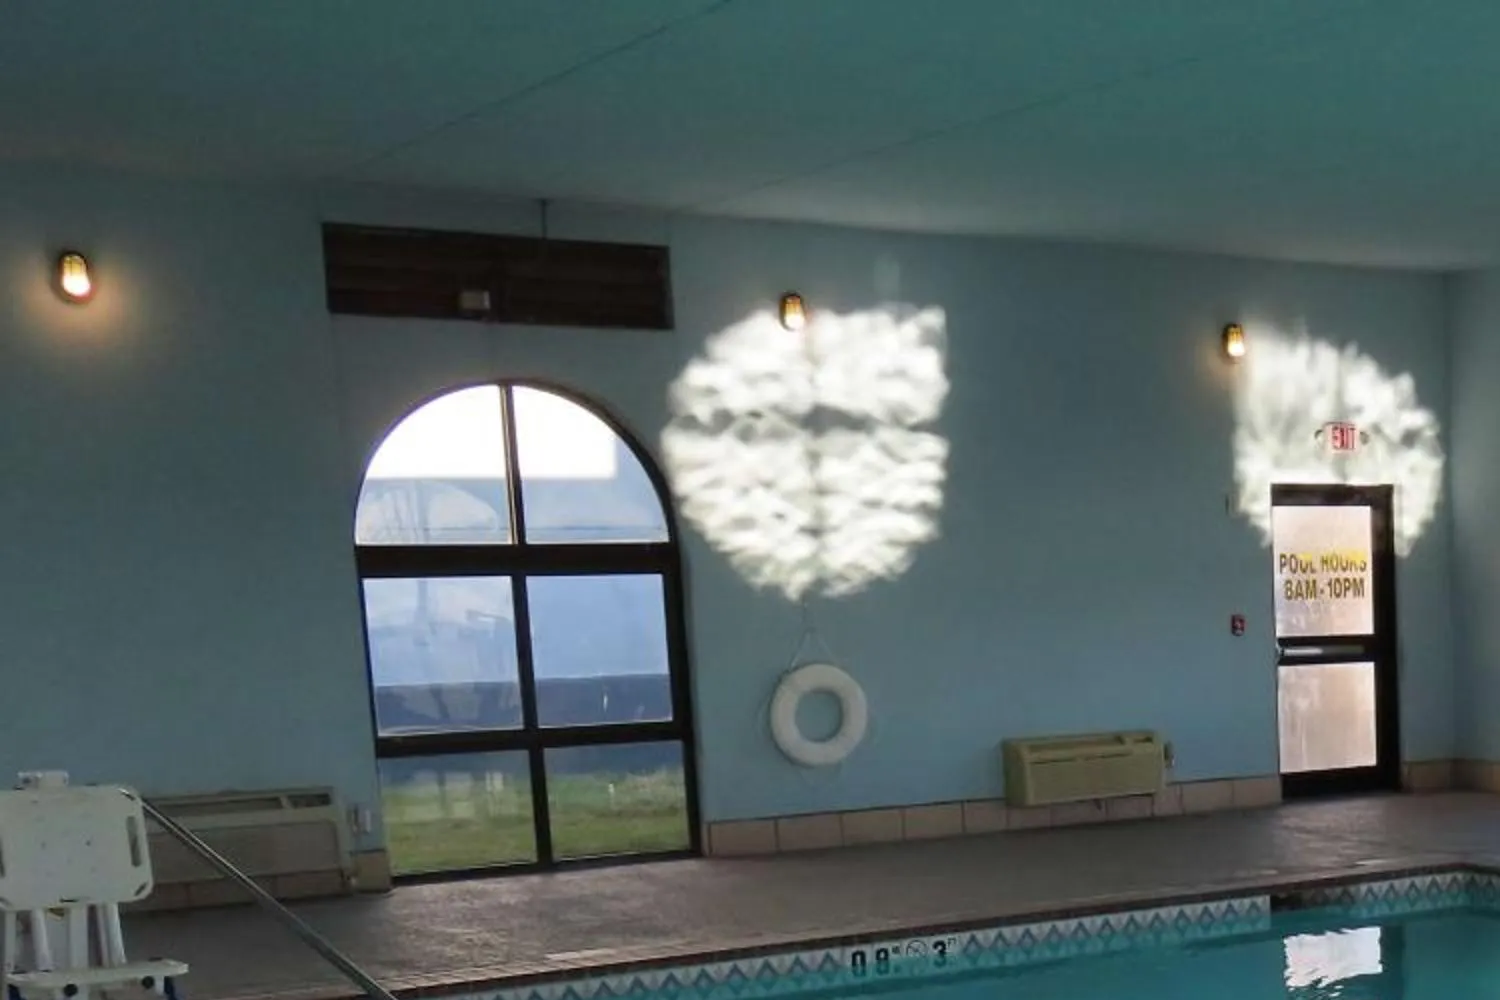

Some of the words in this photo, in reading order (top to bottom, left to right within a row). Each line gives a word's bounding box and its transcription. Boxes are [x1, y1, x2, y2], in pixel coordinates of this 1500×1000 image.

[1331, 426, 1357, 450] EXIT
[1280, 552, 1317, 575] POOL
[1321, 552, 1368, 574] HOURS
